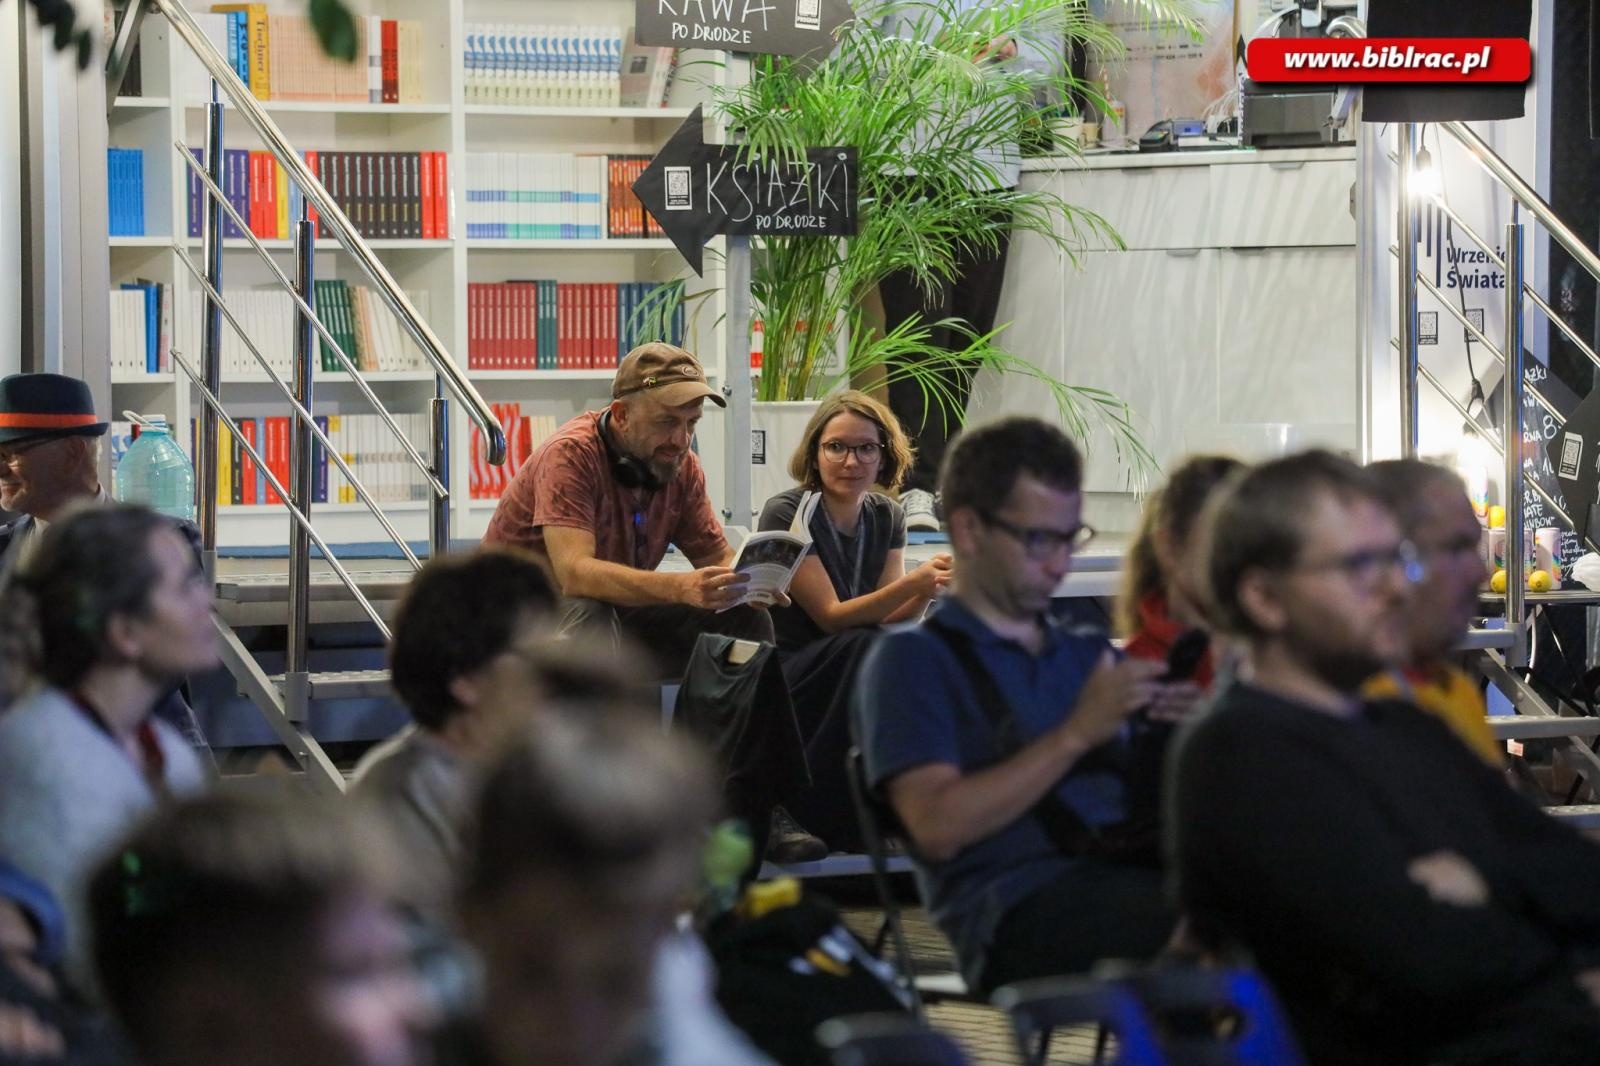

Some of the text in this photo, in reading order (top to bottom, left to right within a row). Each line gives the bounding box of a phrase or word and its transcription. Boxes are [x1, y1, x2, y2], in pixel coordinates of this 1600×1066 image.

[672, 22, 752, 44] PO DRODZE
[755, 215, 827, 230] PO DRODZE
[1446, 245, 1505, 263] Wrzei
